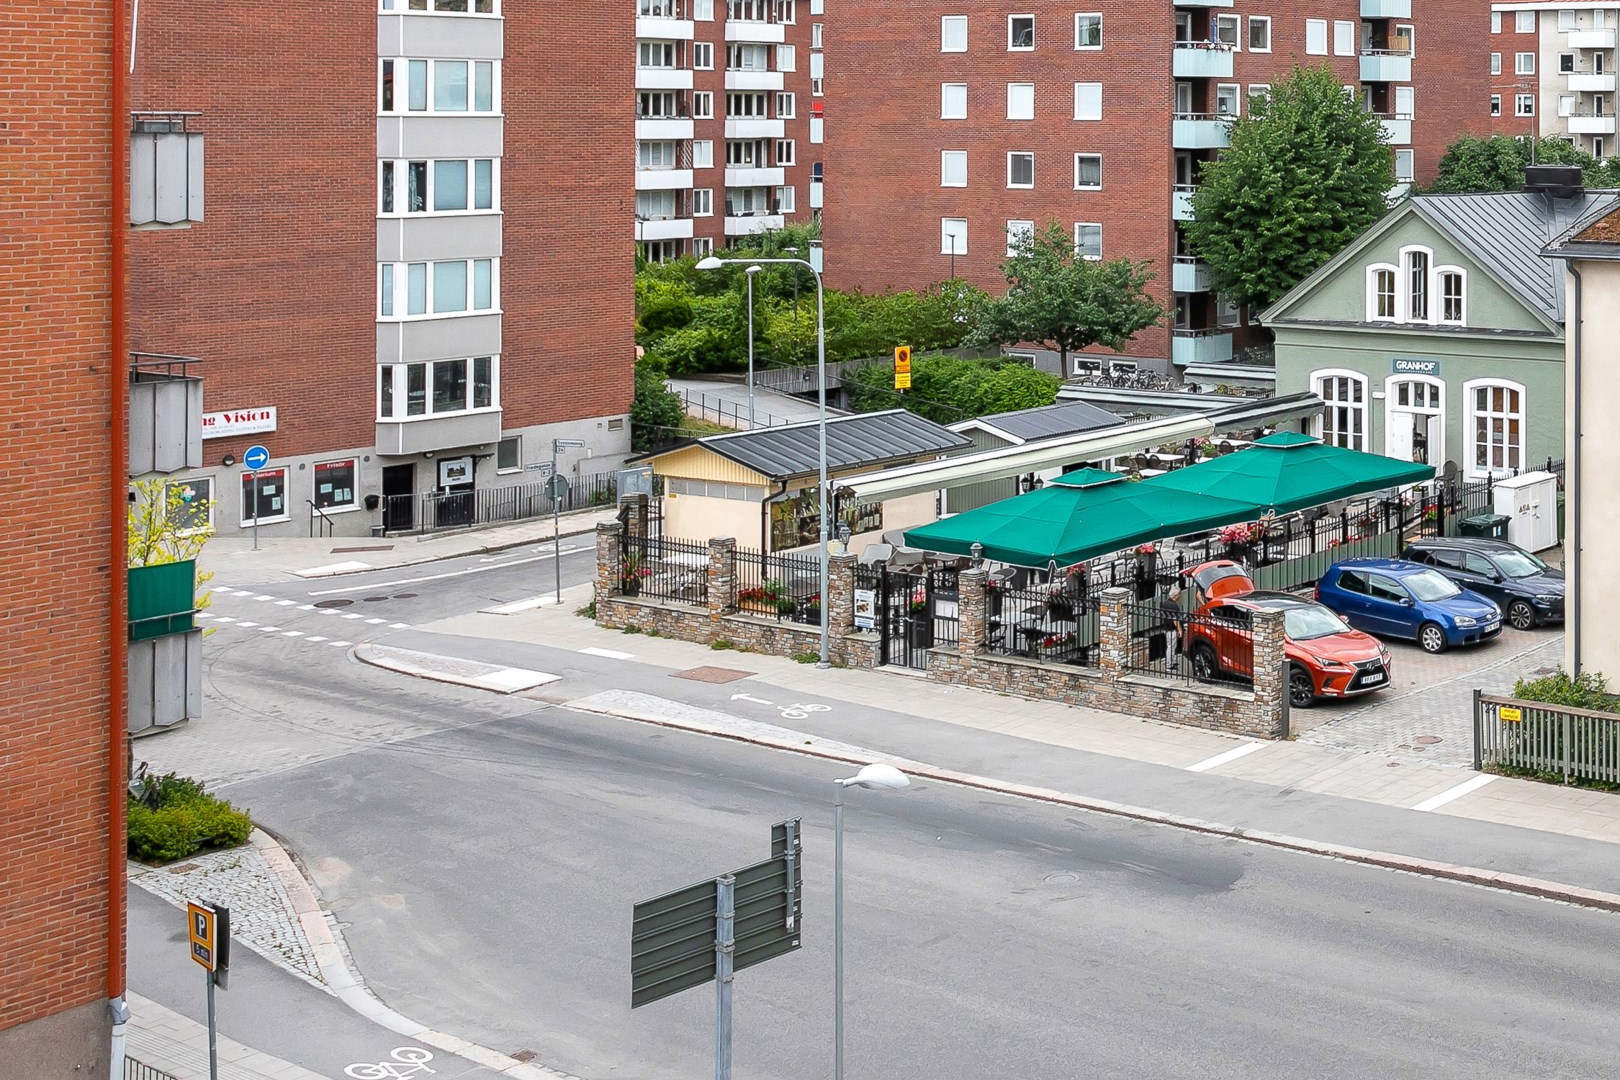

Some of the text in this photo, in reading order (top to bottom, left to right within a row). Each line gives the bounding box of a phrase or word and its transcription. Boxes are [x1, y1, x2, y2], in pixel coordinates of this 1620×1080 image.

[1396, 360, 1435, 371] GRANHOF
[223, 410, 270, 423] Vision
[198, 915, 205, 936] P
[195, 944, 200, 954] 5
